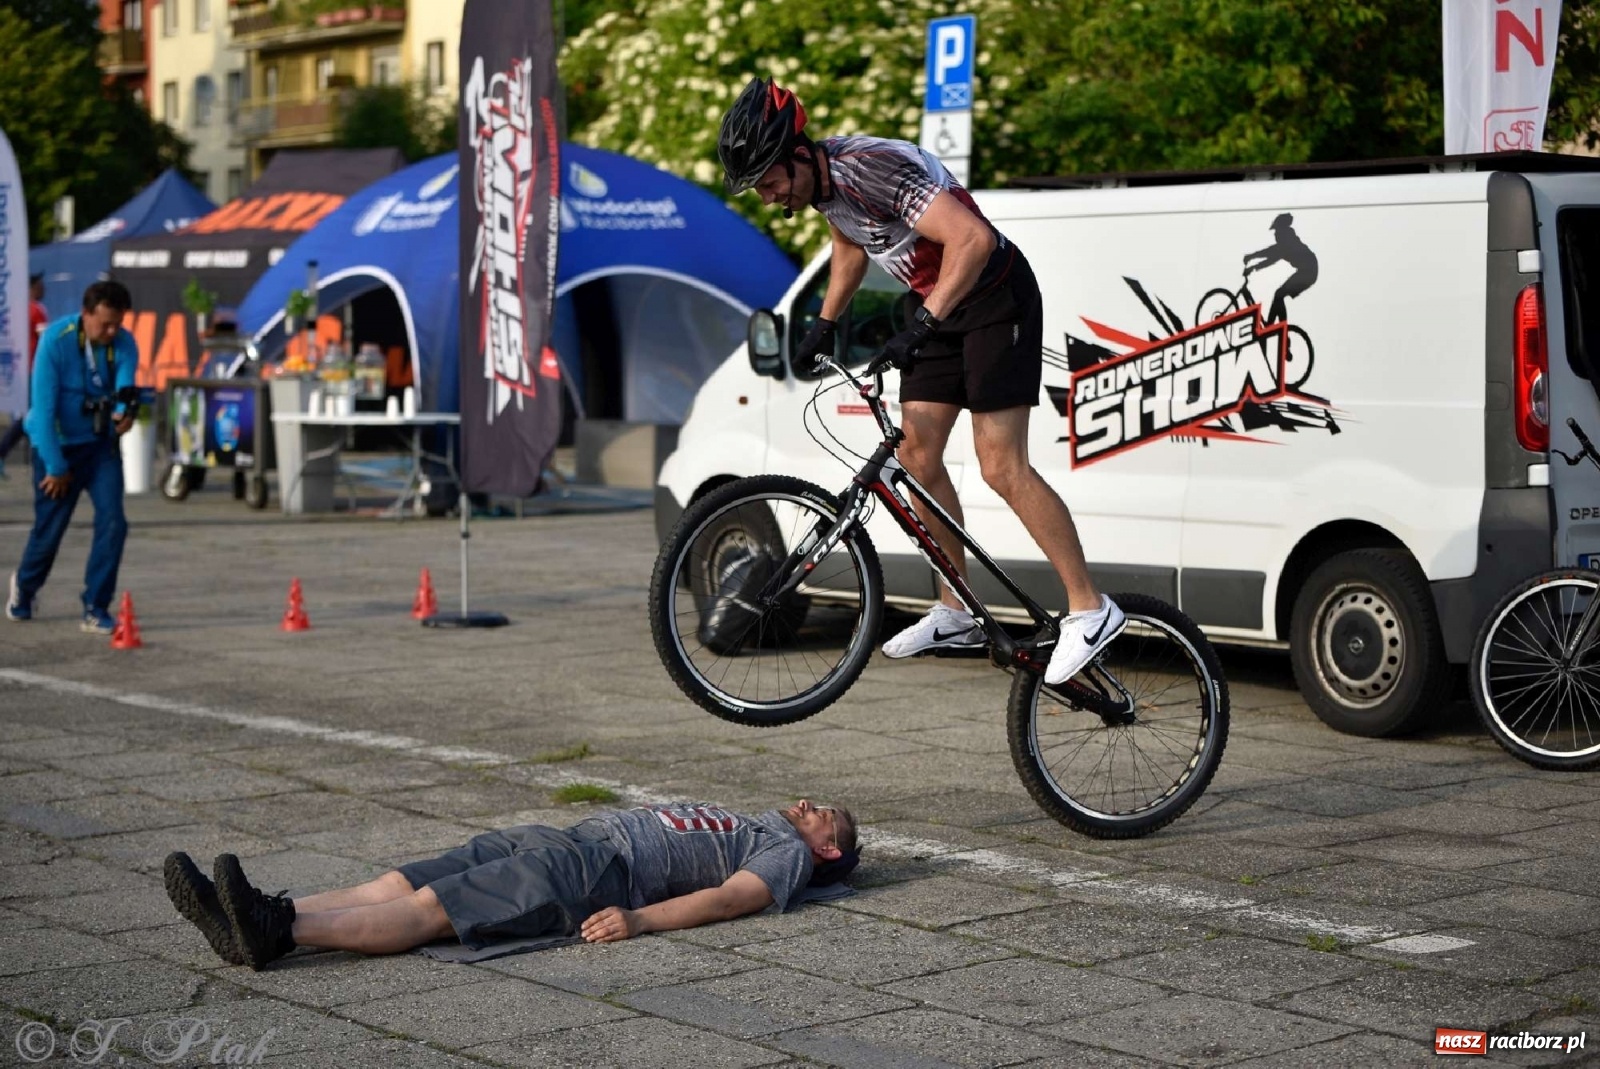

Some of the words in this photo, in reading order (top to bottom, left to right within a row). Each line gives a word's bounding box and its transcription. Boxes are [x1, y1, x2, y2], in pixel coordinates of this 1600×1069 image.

[934, 24, 966, 86] P
[491, 127, 526, 384] SHOW
[1074, 316, 1254, 404] ROWEROWE
[1075, 335, 1280, 459] SHOW
